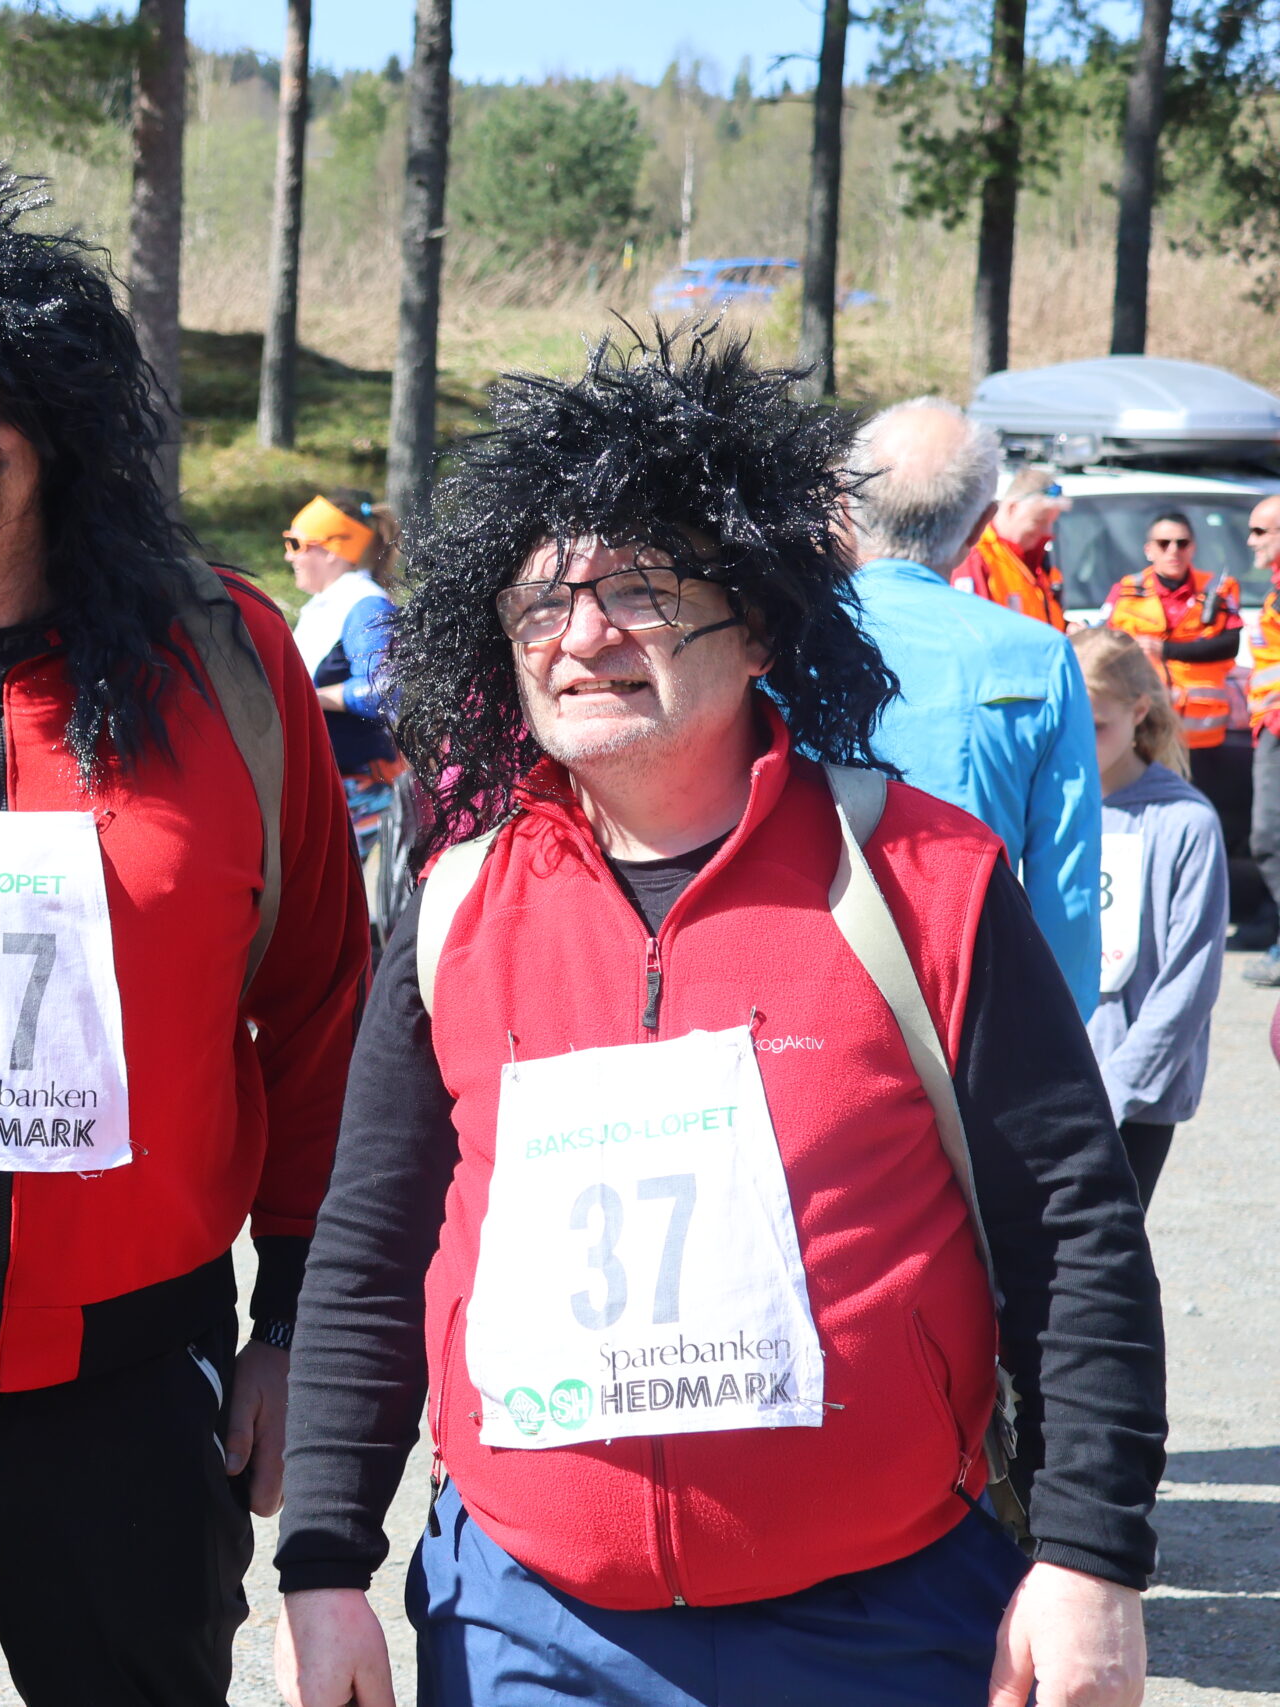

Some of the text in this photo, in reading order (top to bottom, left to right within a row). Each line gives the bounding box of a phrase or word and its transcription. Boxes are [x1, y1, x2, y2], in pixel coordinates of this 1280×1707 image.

[753, 1035, 824, 1054] kogAktiv
[569, 1173, 697, 1331] 37
[599, 1330, 791, 1380] Sparebanken
[552, 1387, 590, 1424] SH
[600, 1372, 792, 1416] HEDMARK
